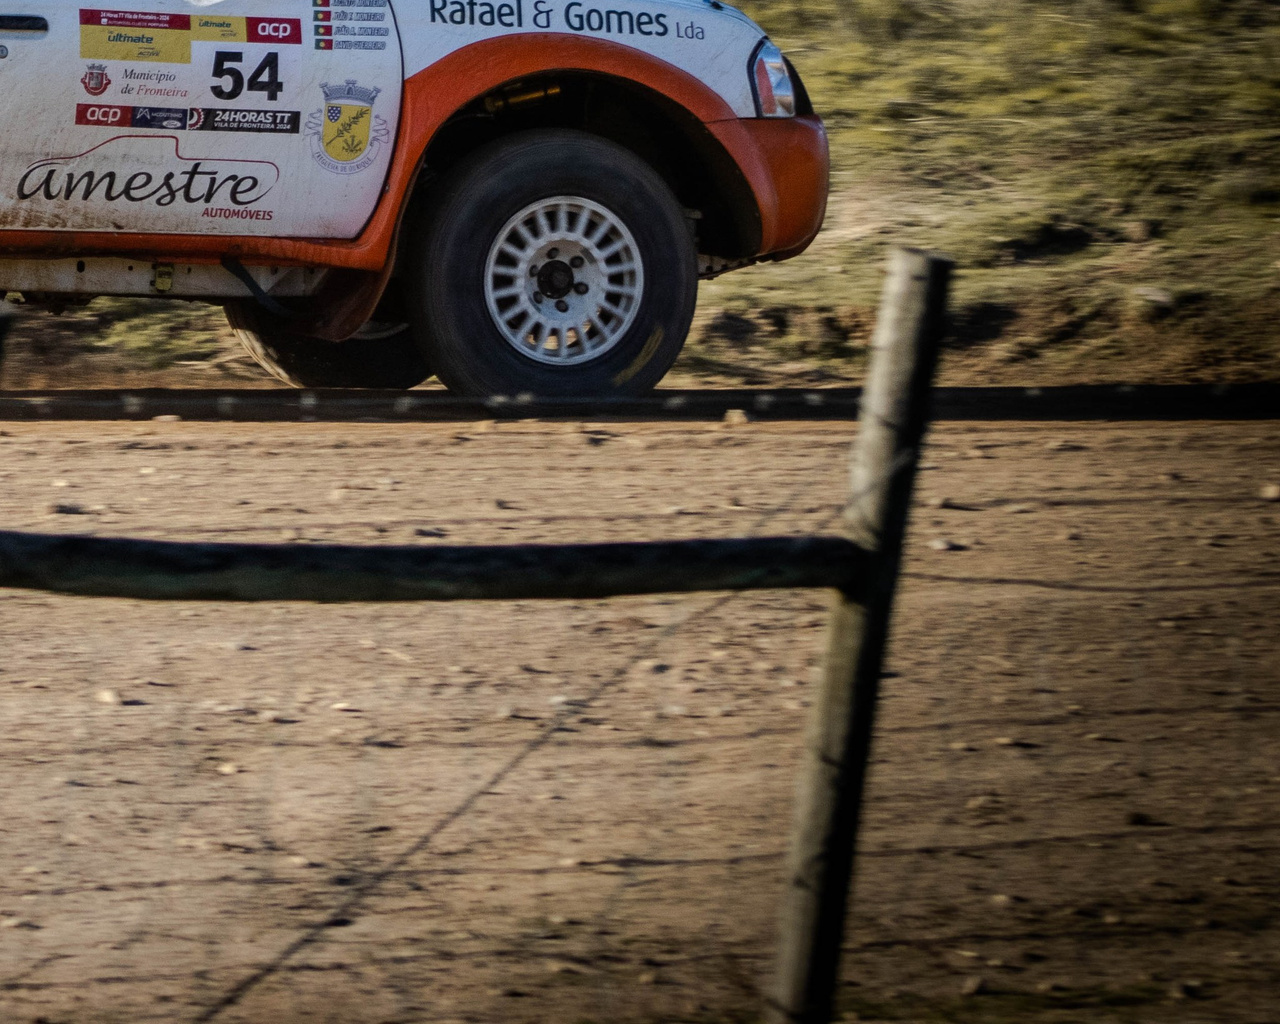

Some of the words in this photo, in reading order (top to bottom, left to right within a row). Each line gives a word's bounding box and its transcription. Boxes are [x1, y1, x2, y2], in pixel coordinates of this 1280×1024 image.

[199, 19, 232, 28] ultimate
[354, 12, 385, 21] MONTEIRO
[532, 0, 554, 29] &
[564, 1, 669, 37] Gomes
[675, 21, 705, 40] Lda
[258, 22, 291, 38] acp
[357, 26, 389, 36] MONTEIRO
[108, 33, 154, 43] ultimate
[122, 69, 176, 84] Município
[209, 51, 283, 101] 54
[121, 84, 134, 95] de
[136, 84, 188, 97] Fronteira
[86, 107, 121, 124] acp
[214, 111, 273, 123] 24HORAS
[275, 112, 291, 124] TT
[16, 161, 274, 207] amestre
[202, 207, 274, 221] AUTOMÓVEIS
